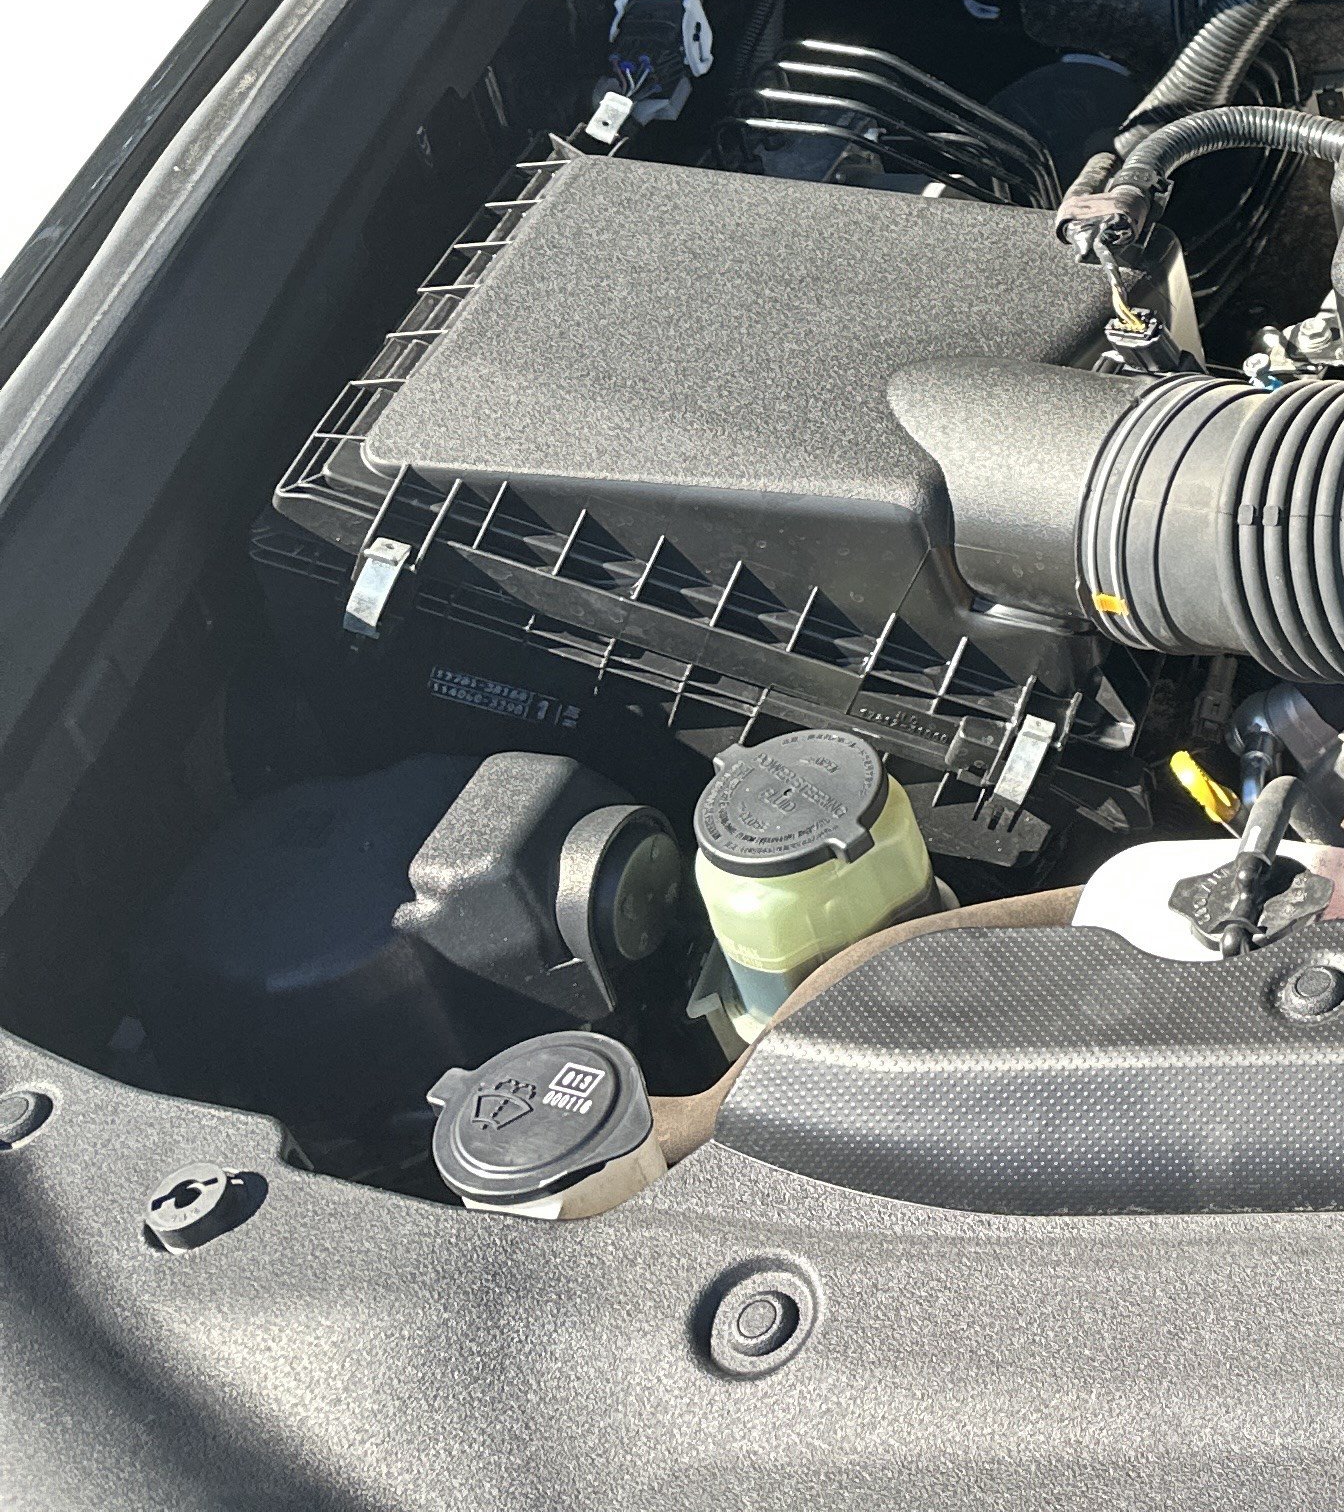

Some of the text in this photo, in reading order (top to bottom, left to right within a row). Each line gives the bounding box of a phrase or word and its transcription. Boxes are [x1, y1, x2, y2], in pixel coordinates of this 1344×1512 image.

[753, 752, 797, 785] POWER
[794, 776, 849, 819] STEERING
[758, 788, 797, 815] FLUID
